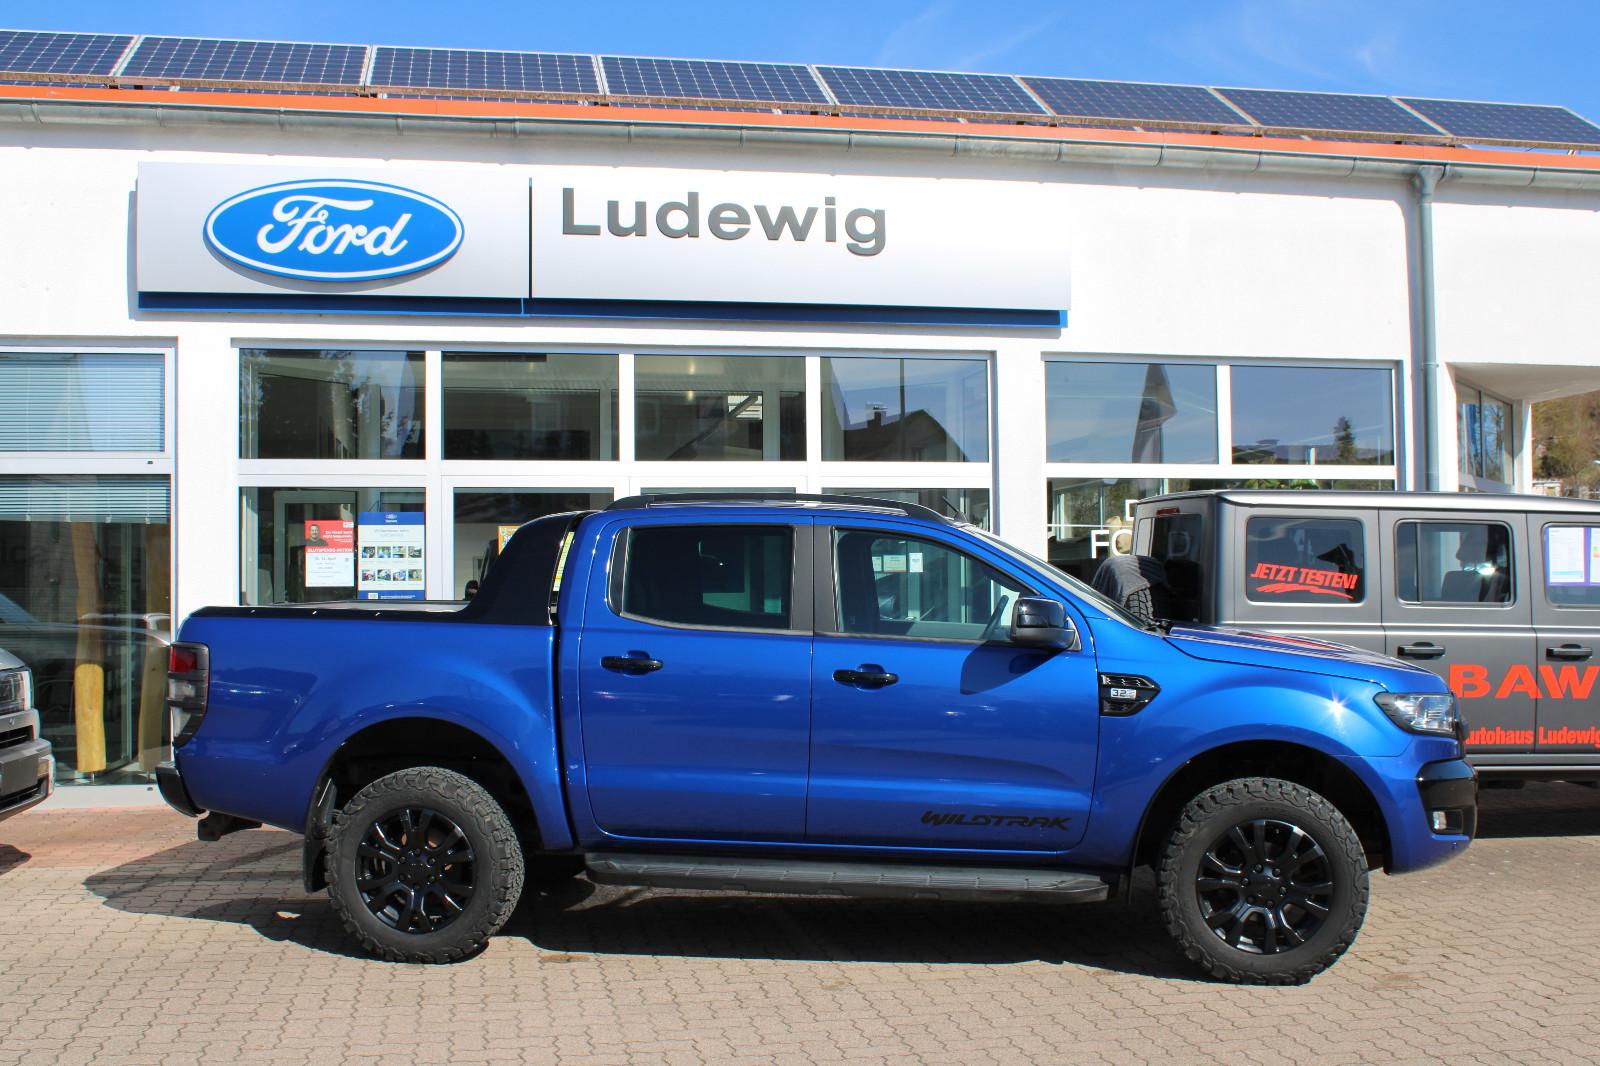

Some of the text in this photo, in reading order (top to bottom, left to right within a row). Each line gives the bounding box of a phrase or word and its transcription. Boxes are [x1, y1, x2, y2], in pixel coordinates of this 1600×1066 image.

[256, 195, 413, 256] Ford
[562, 187, 886, 257] Ludewig
[1250, 562, 1358, 589] JETZT TESTEN!
[1449, 663, 1600, 700] BAW
[921, 810, 1072, 831] WILDTRAK
